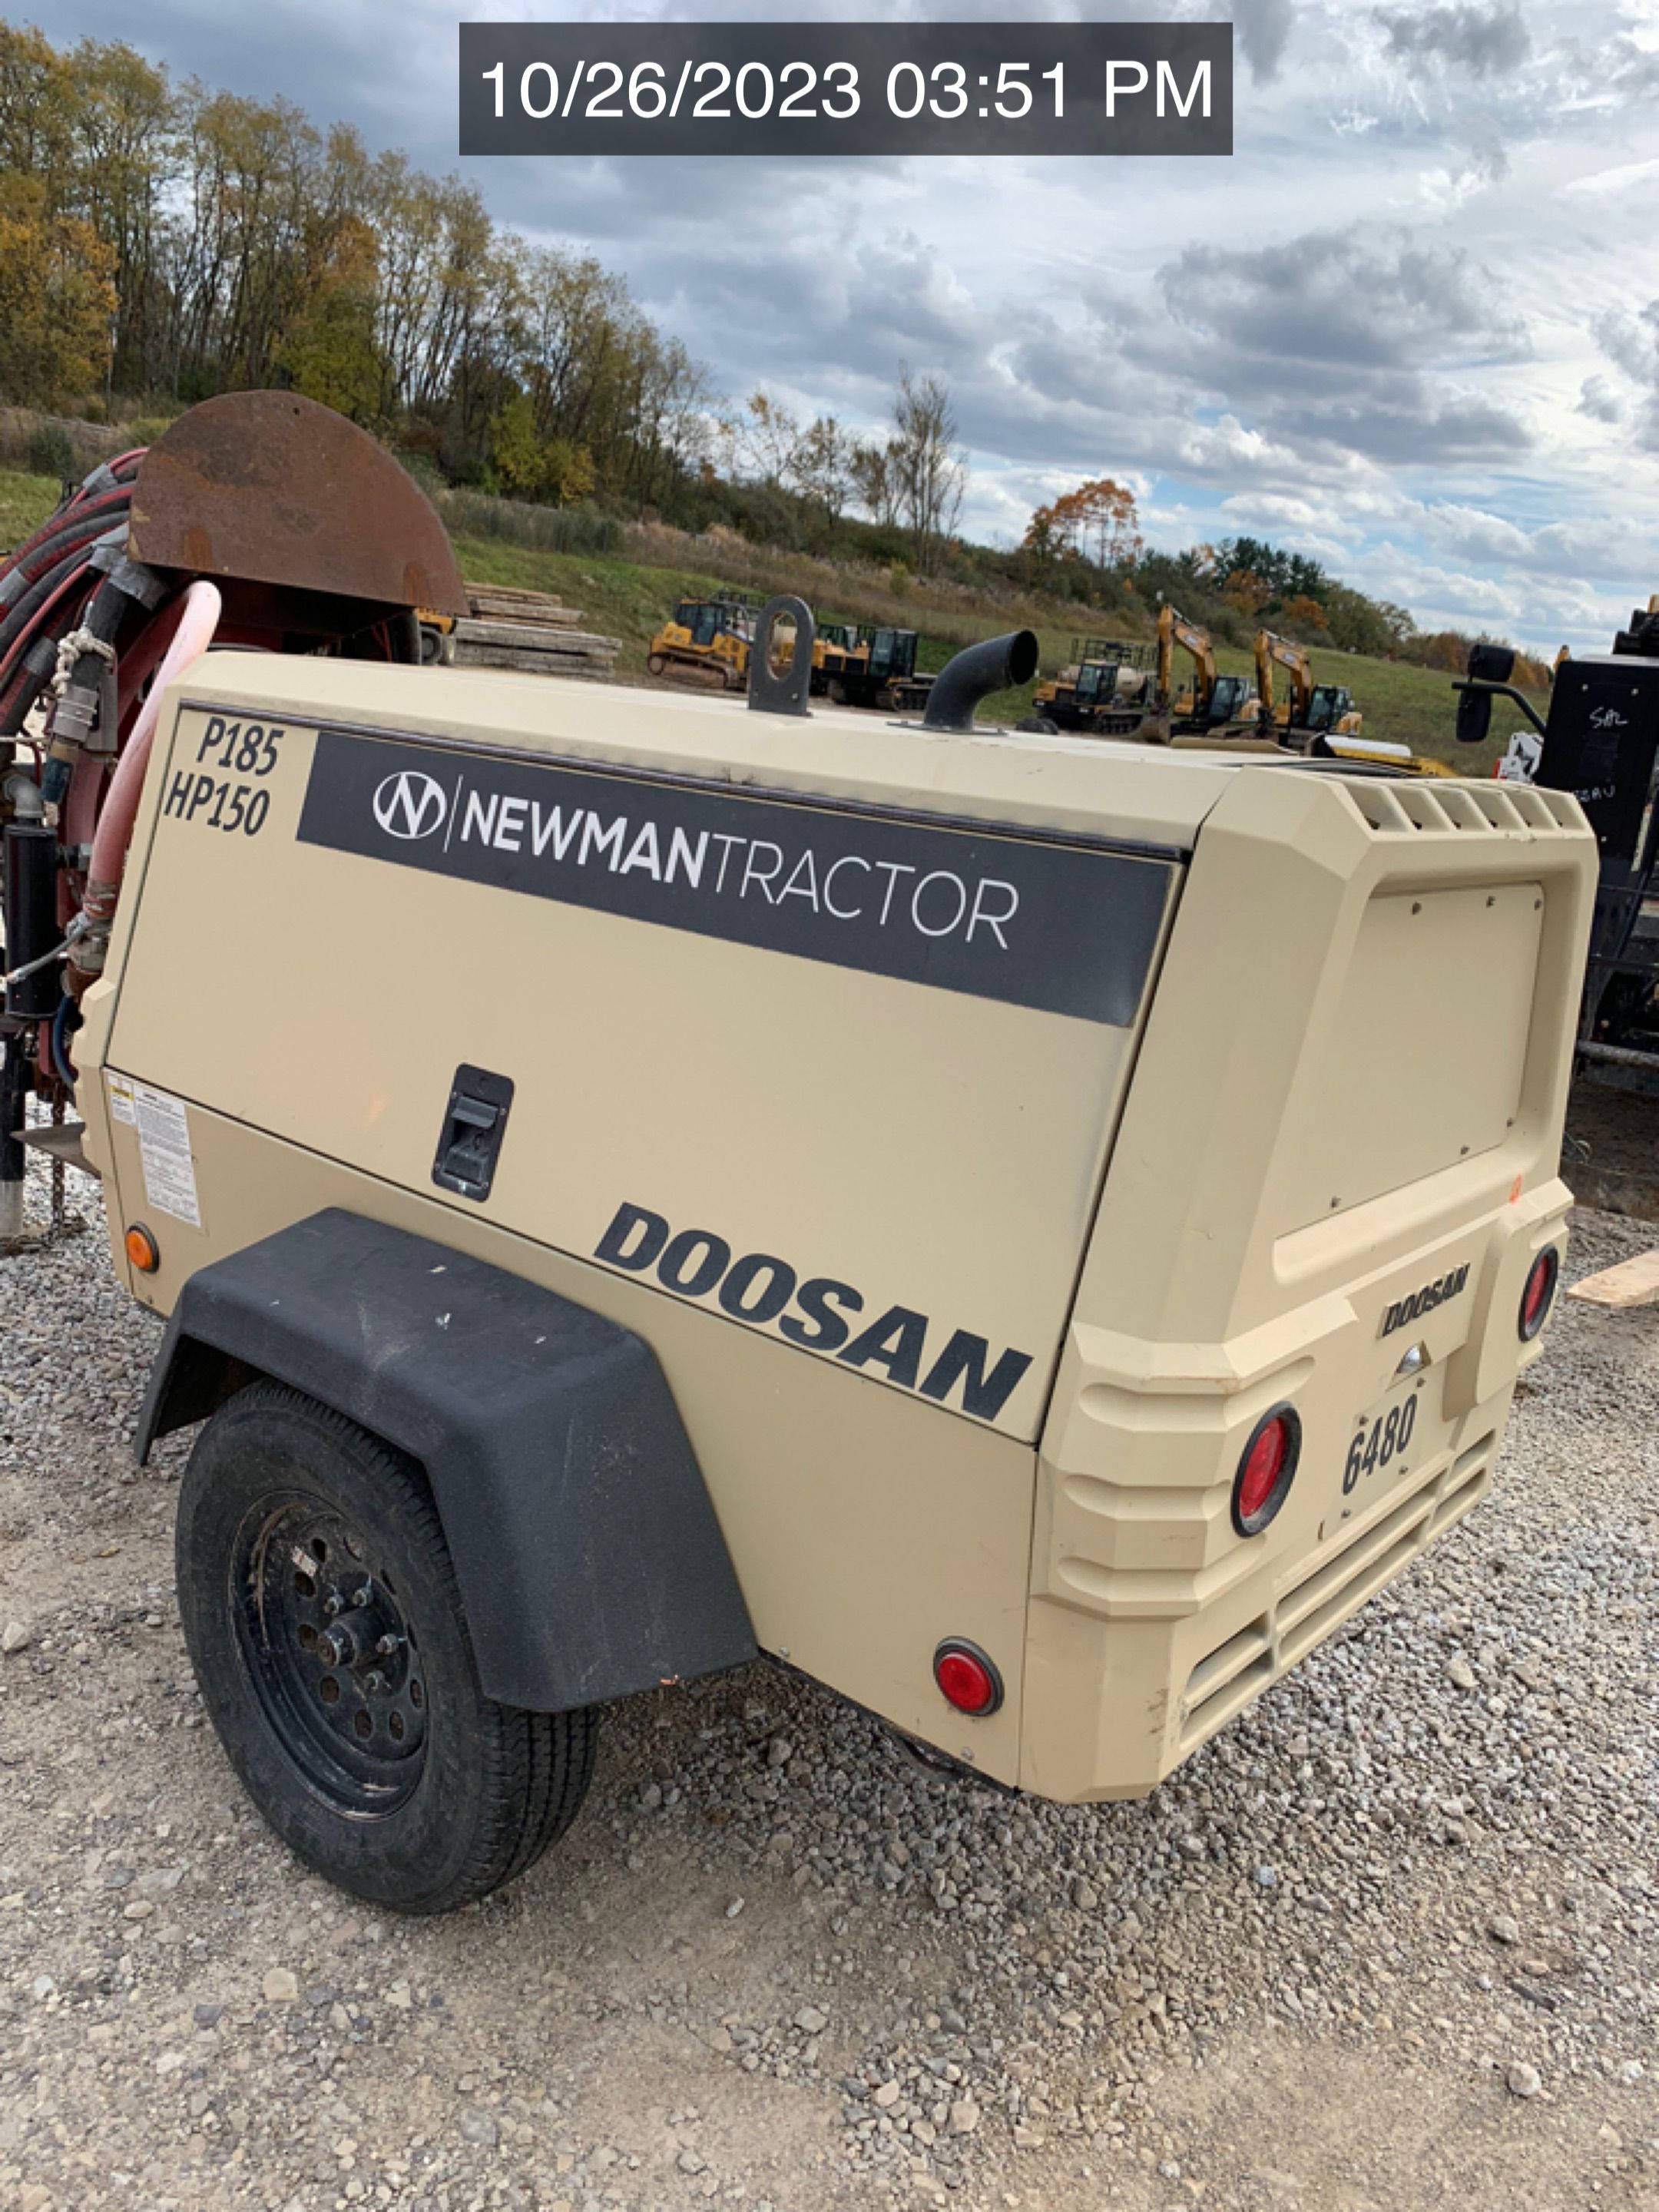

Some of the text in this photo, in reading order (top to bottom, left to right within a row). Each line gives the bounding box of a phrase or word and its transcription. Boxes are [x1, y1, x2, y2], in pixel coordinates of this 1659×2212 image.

[196, 716, 286, 777] P185
[164, 770, 270, 836] HP150
[593, 1201, 1035, 1422] DOOSAN
[1381, 1262, 1471, 1338] DOOSAN
[1343, 1393, 1417, 1495] 6480
